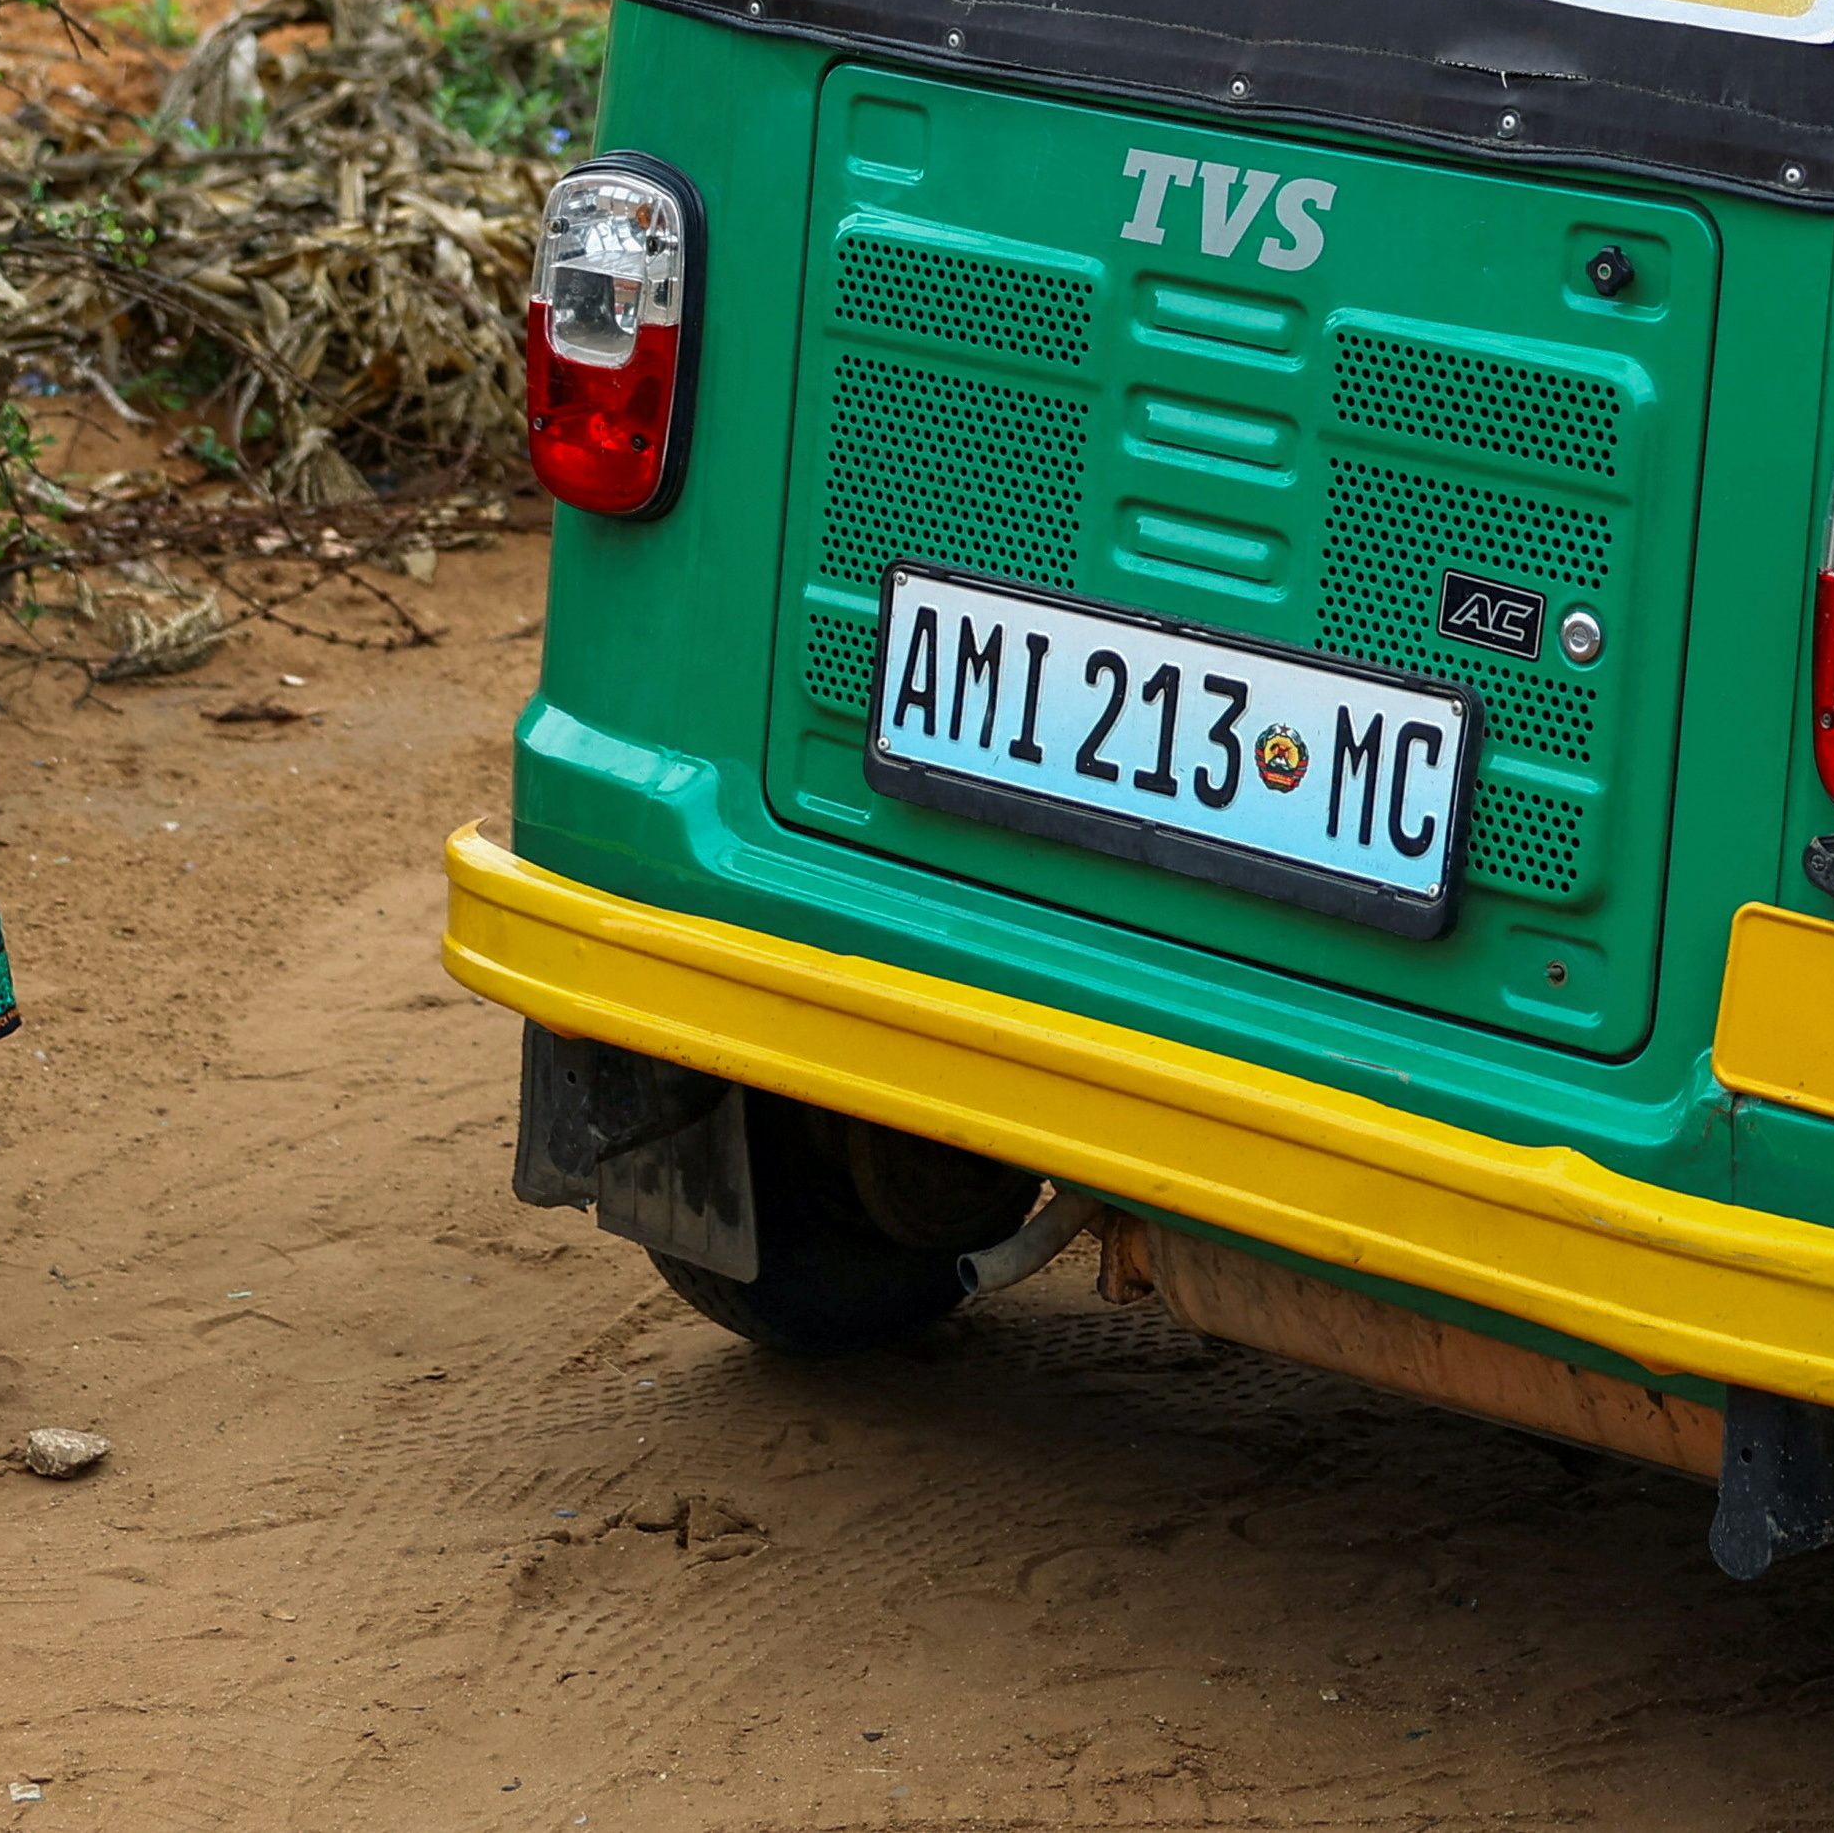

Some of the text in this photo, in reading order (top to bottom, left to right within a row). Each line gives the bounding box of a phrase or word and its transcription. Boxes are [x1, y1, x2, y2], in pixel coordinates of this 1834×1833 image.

[1119, 147, 1338, 272] TVS
[1448, 593, 1534, 644] AC
[892, 606, 1445, 858] AMI 213 MC
